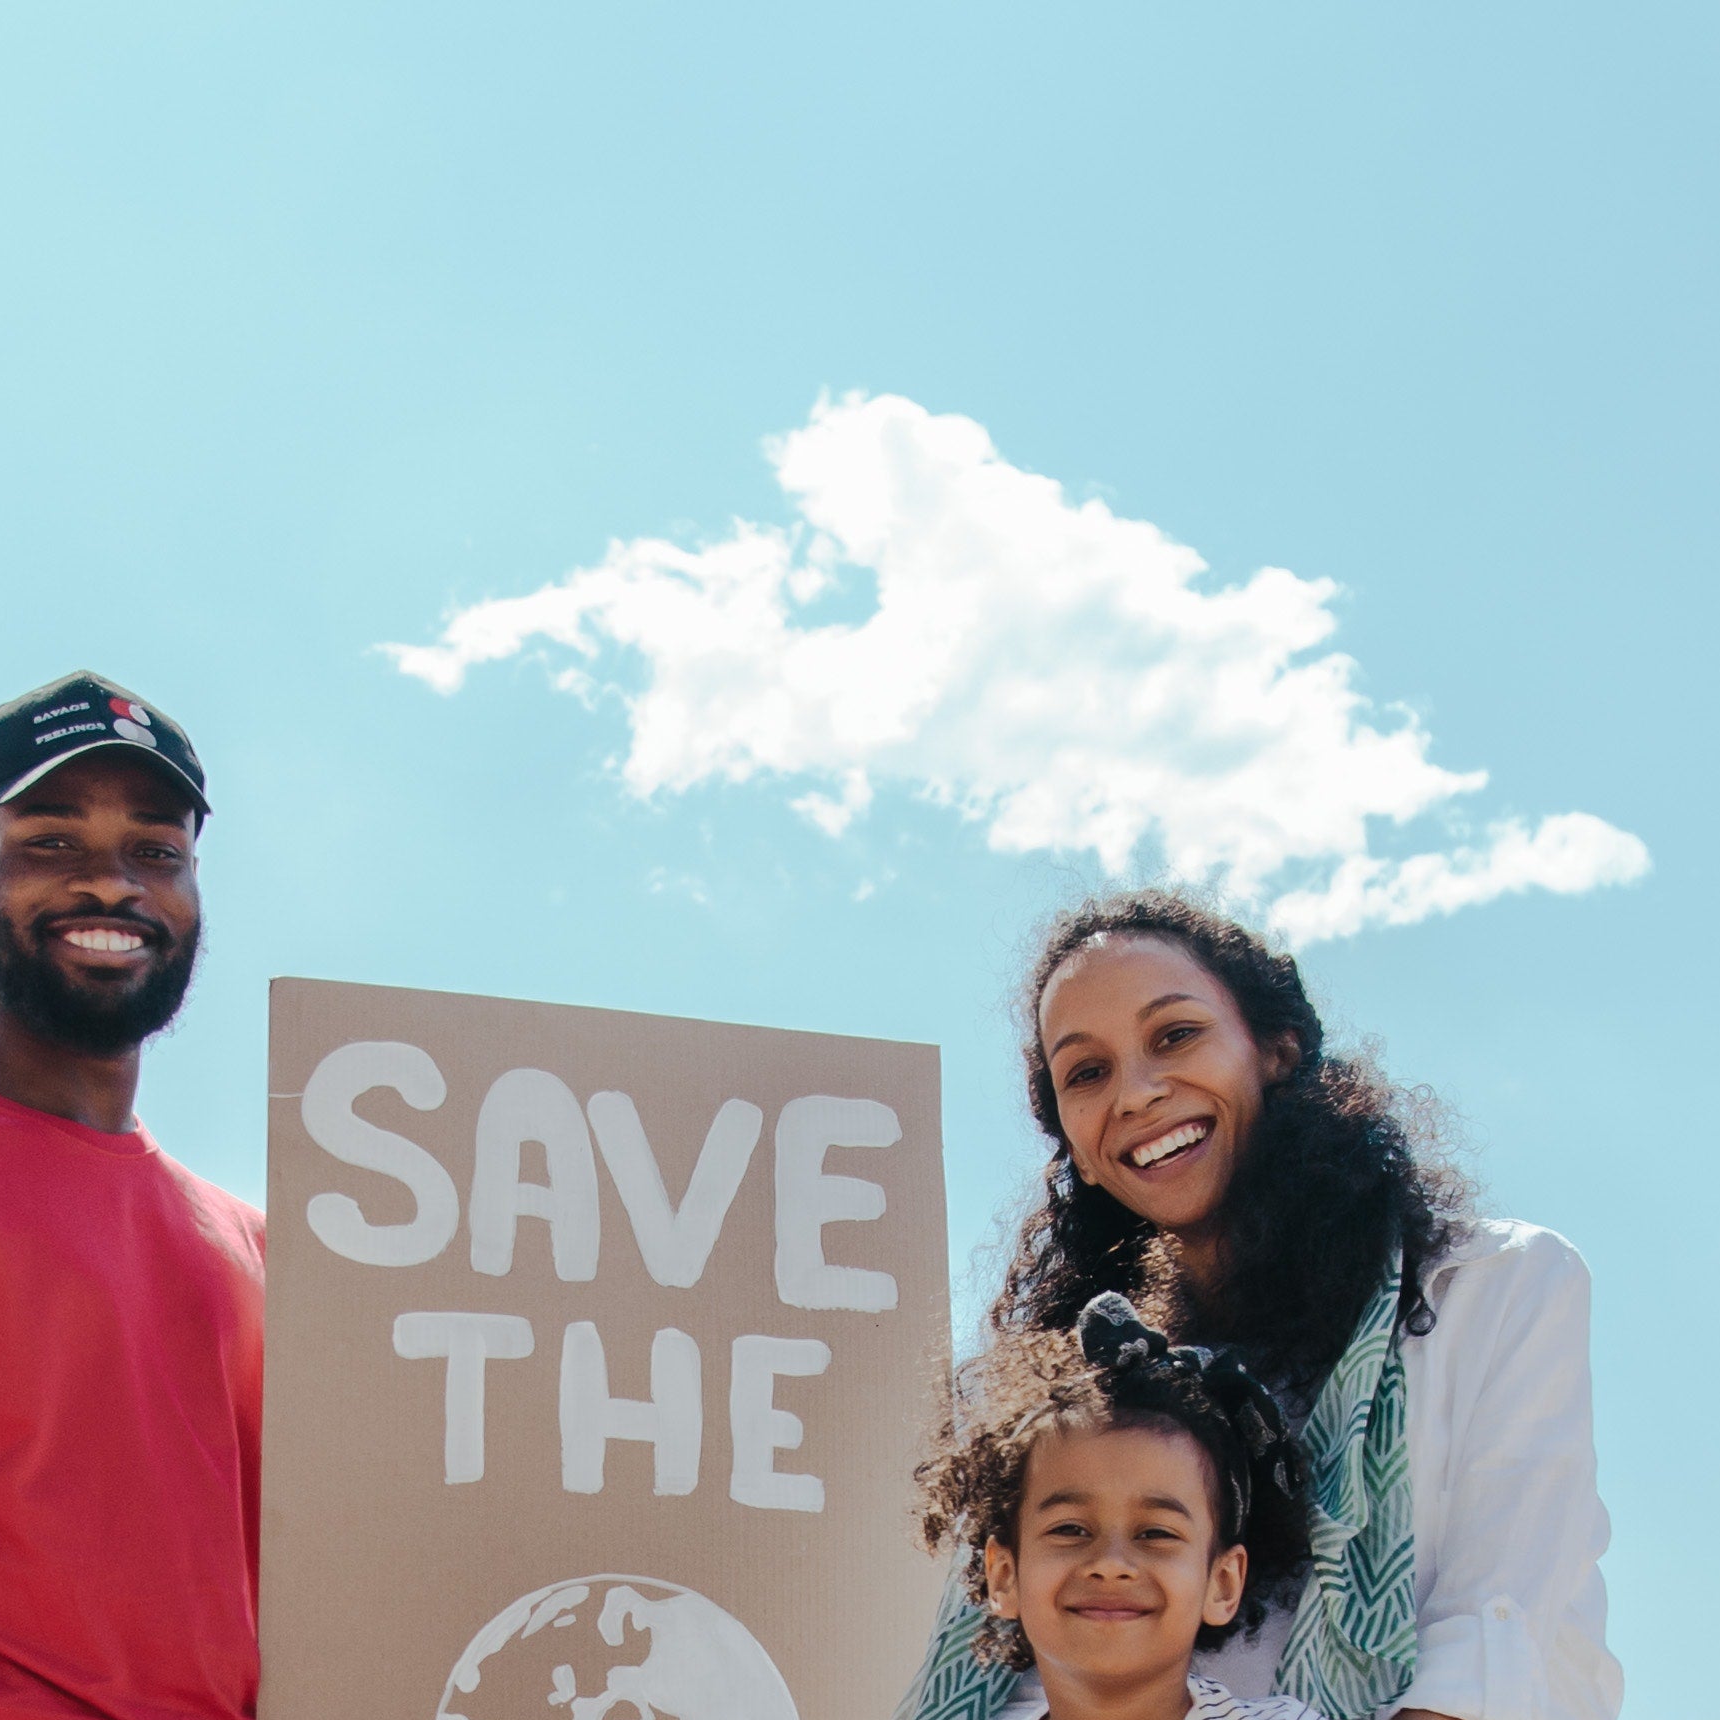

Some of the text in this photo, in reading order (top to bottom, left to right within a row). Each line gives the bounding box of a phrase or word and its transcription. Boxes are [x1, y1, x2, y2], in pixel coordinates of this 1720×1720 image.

[33, 702, 90, 723] SAVAGE
[35, 722, 106, 745] FEELINGS
[301, 1040, 903, 1313] SAVE
[393, 1313, 833, 1513] THE
